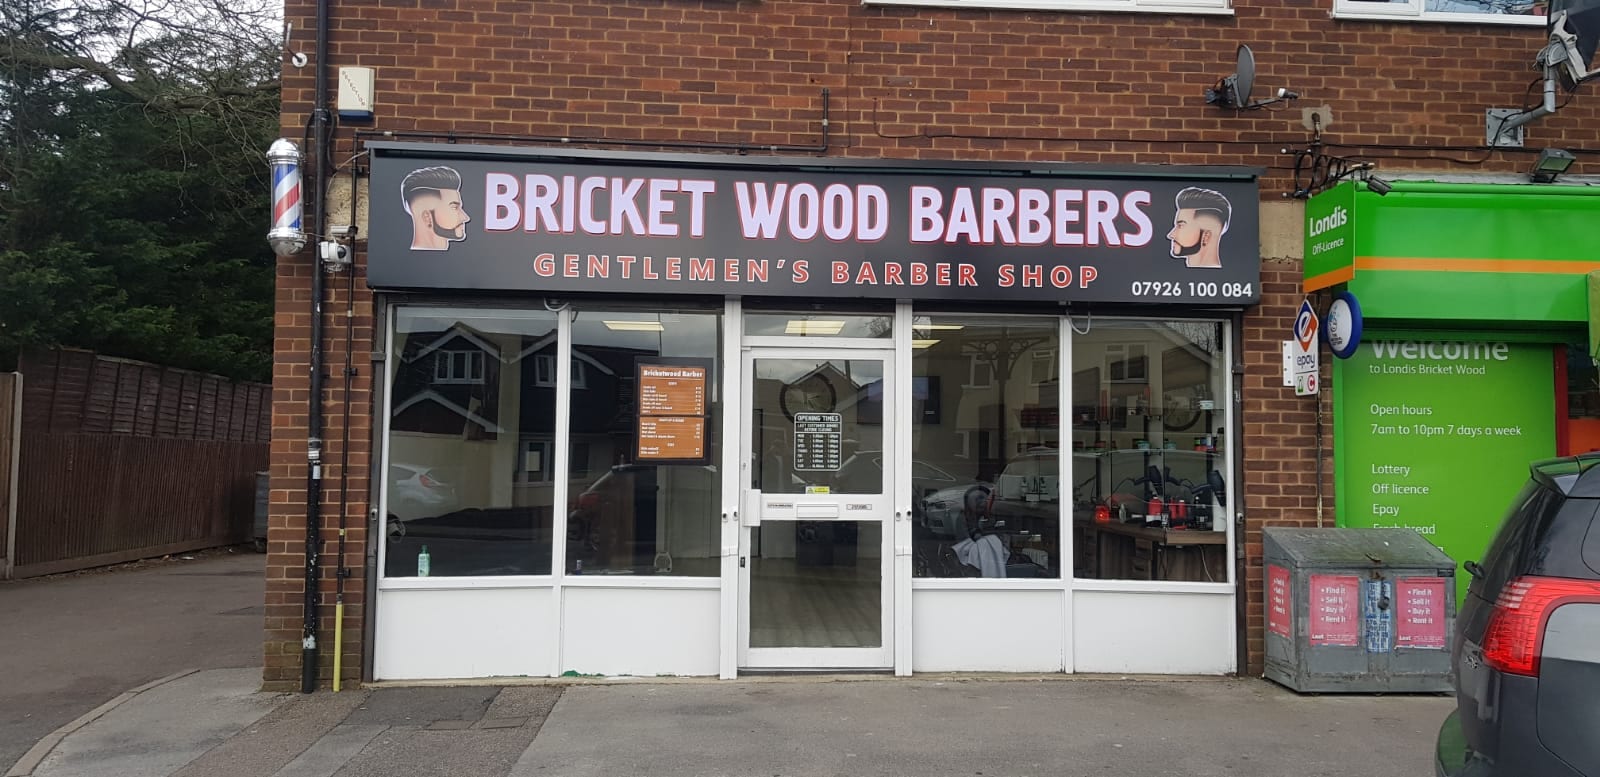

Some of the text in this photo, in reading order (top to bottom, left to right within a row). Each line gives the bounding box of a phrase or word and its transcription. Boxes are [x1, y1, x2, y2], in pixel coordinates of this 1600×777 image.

[484, 172, 1153, 248] BRICKET WOOD BARBERS
[1309, 206, 1347, 237] Londis
[1312, 238, 1344, 255] Off-Licence
[831, 260, 978, 287] BARBER
[998, 264, 1098, 289] SHOP
[1131, 281, 1253, 298] 07926 100 084
[1372, 342, 1509, 361] Welcome
[1296, 354, 1316, 369] epay
[1369, 364, 1486, 375] to Londis Bricket Wood
[1370, 404, 1433, 417] Open hours
[1371, 424, 1522, 438] 7am to 10pm 7 days a week
[1371, 463, 1411, 477] Lottery
[1372, 483, 1430, 494] Off licence
[1372, 503, 1400, 516] Epay
[1325, 587, 1340, 595] Find
[1411, 598, 1424, 606] Sell
[1325, 606, 1338, 615] Buy
[1412, 608, 1425, 616] Buy
[1412, 617, 1427, 625] Rent
